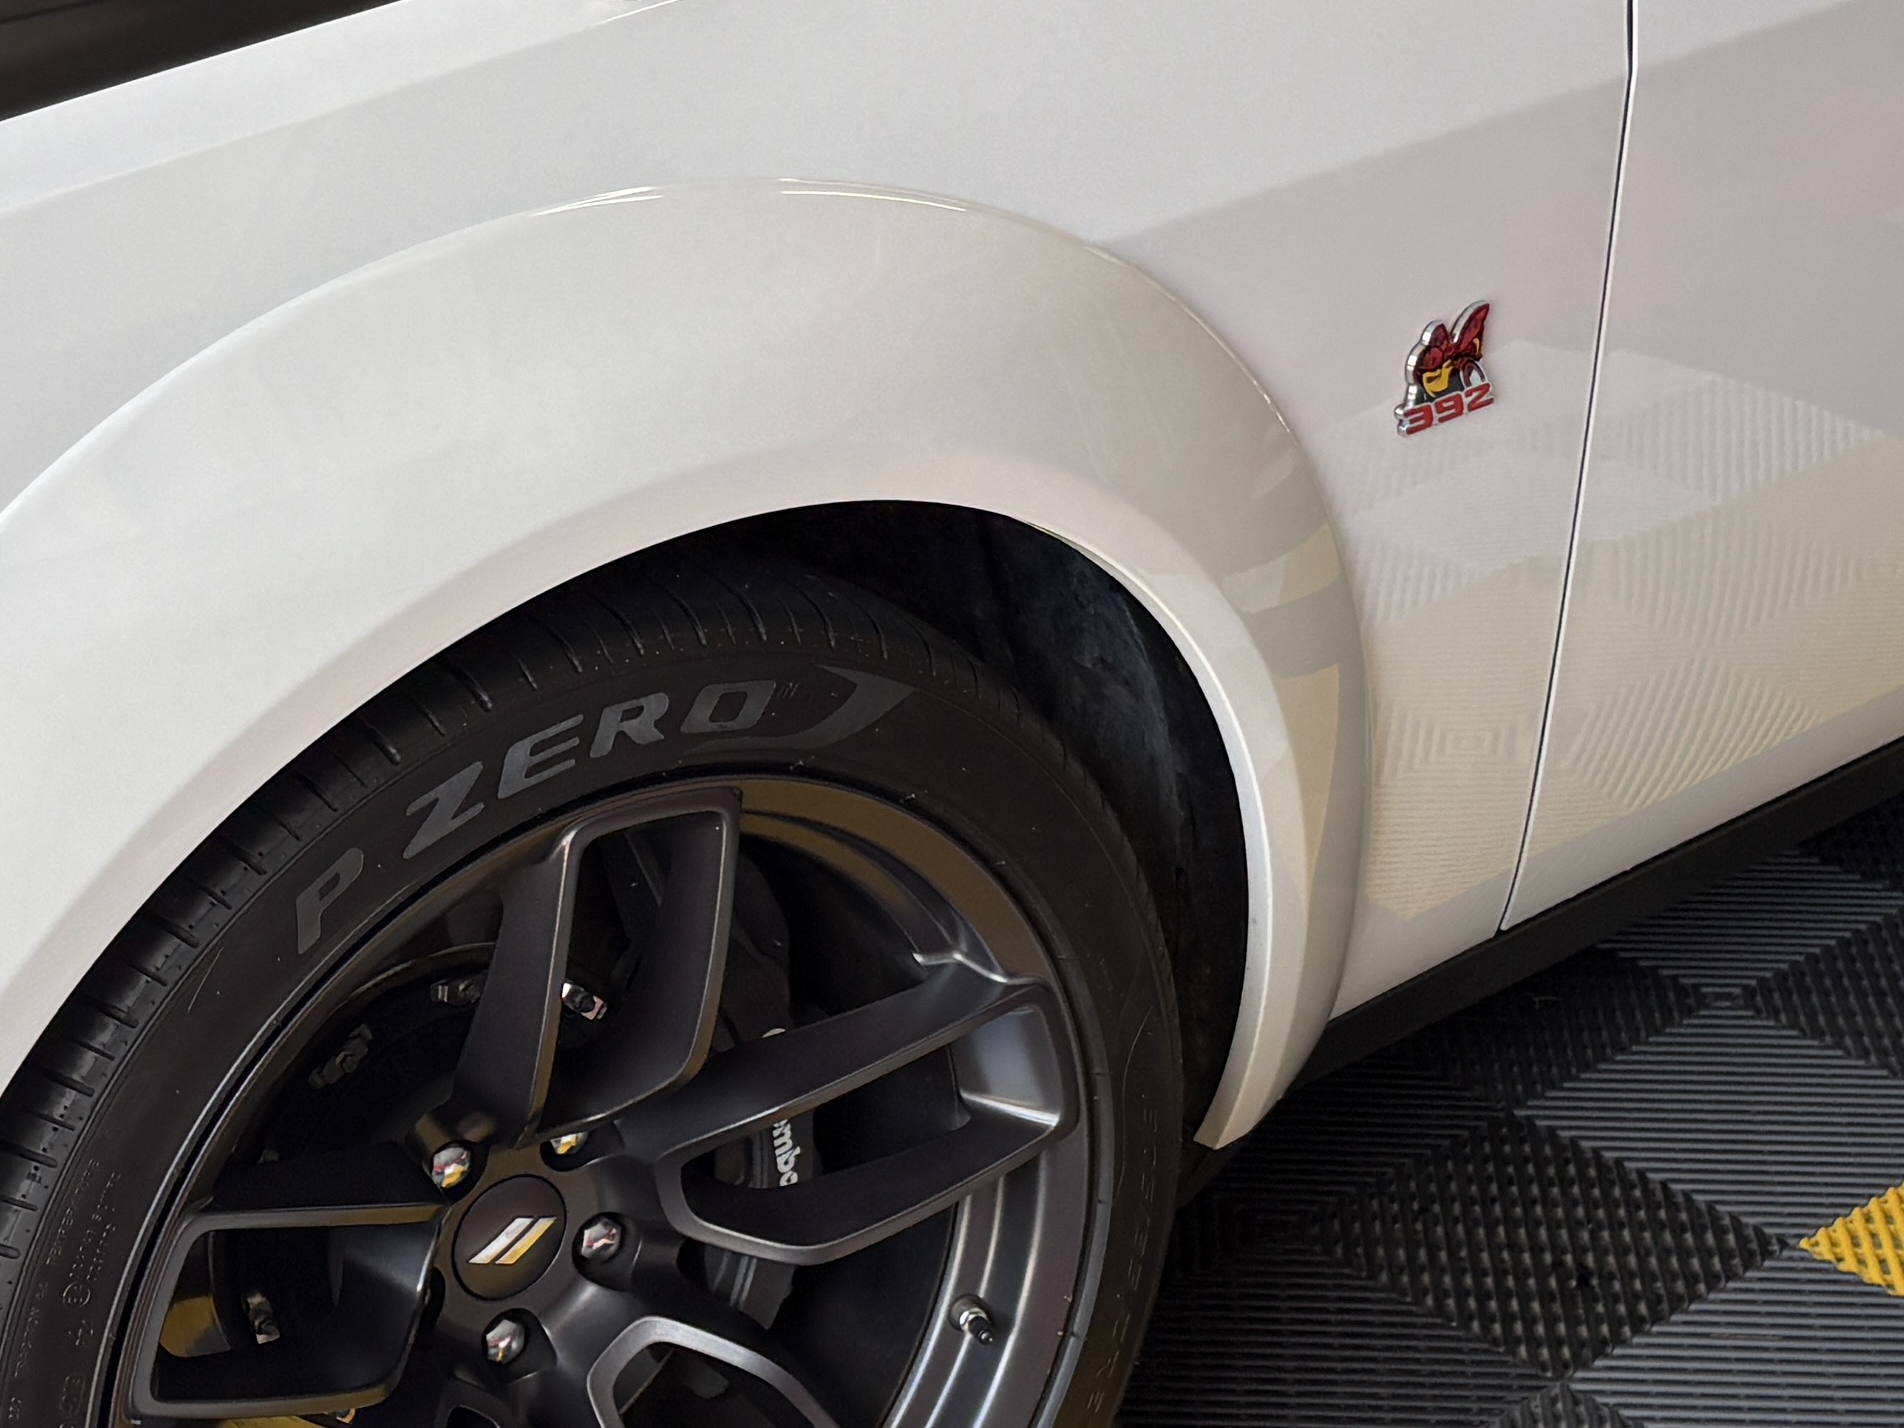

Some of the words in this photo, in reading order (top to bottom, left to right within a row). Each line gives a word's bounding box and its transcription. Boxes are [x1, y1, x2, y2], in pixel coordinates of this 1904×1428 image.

[1403, 382, 1495, 436] 392
[297, 847, 365, 955] P
[403, 679, 777, 860] ZERO
[772, 1119, 801, 1187] mbo
